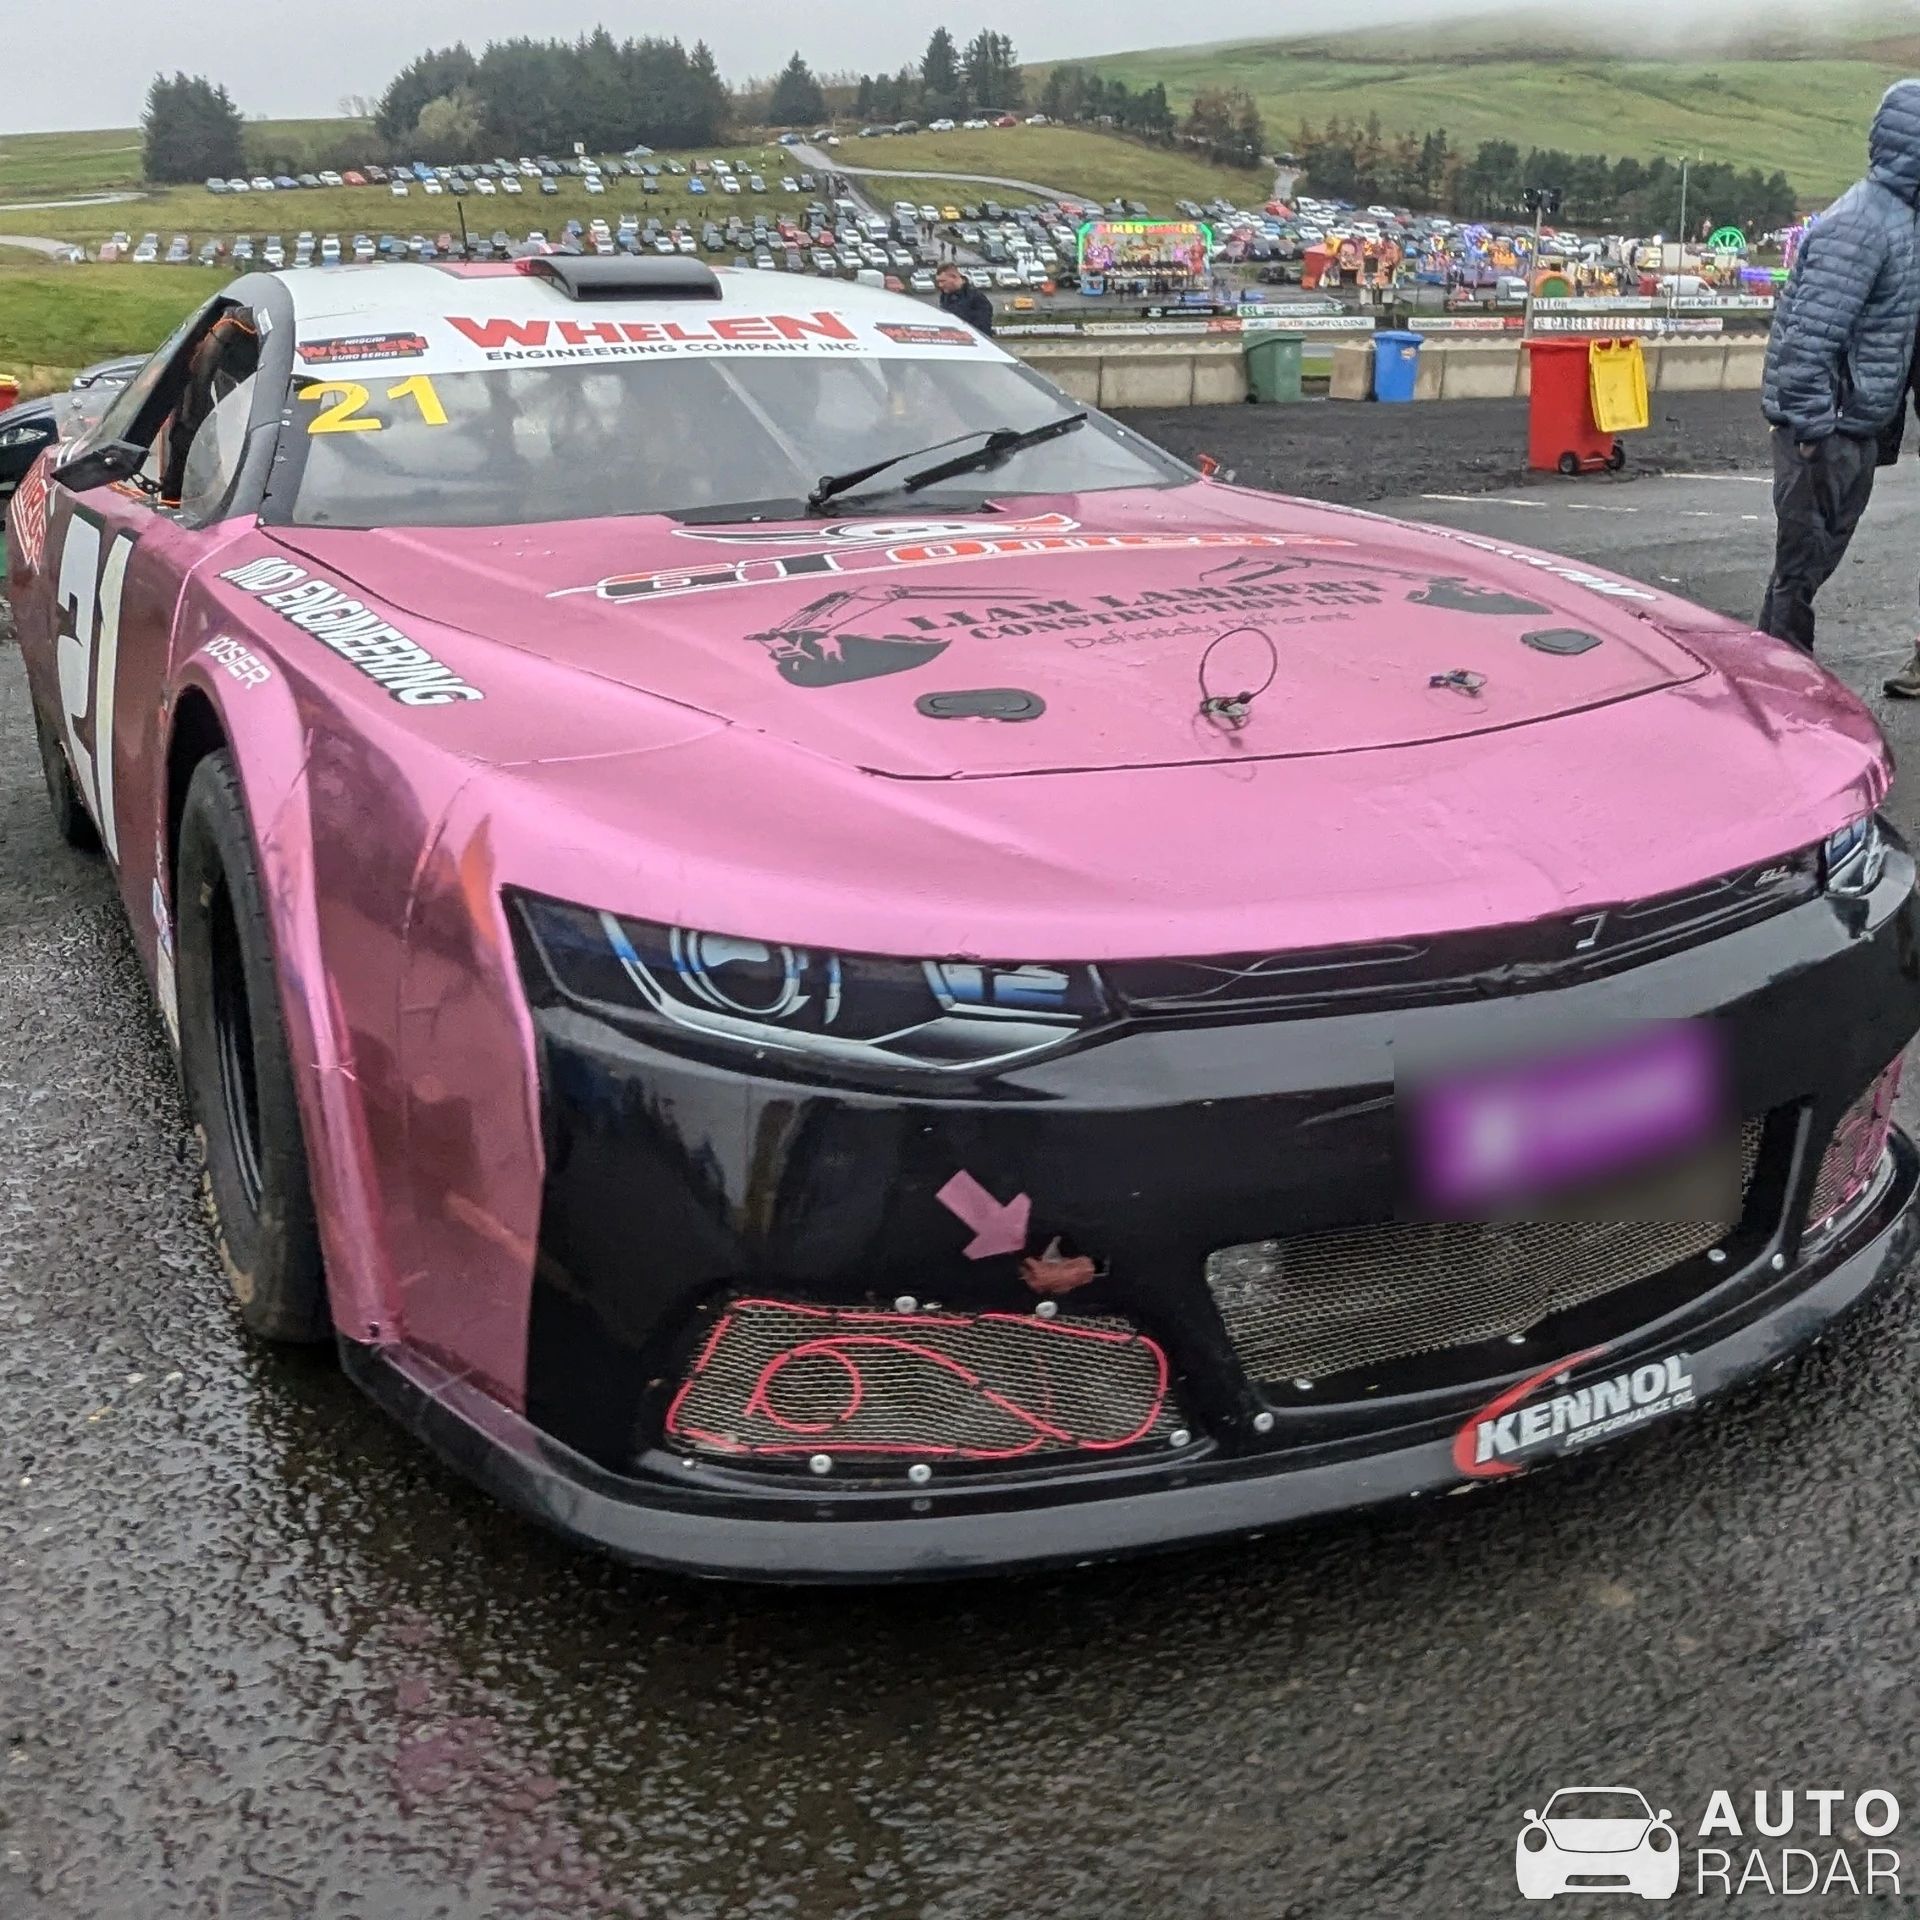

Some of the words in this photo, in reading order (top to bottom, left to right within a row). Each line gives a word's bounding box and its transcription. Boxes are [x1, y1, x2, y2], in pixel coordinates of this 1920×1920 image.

[344, 336, 386, 345] NASCAR
[444, 312, 858, 348] WHELEN
[486, 344, 678, 361] ENGINEERING
[685, 342, 810, 353] COMPANY
[818, 342, 869, 352] INC.
[331, 353, 359, 361] EURO
[298, 376, 449, 435] 21
[903, 599, 1087, 631] LIAM
[1094, 580, 1388, 610] LAMBERT
[970, 597, 1301, 641] CONSTRUCTION
[1304, 594, 1383, 606] LTD
[254, 578, 487, 707] ENGINEERING
[1064, 621, 1221, 650] Definitely
[1475, 1354, 1693, 1464] KENNOL
[1564, 1397, 1672, 1447] PERFORMANCE
